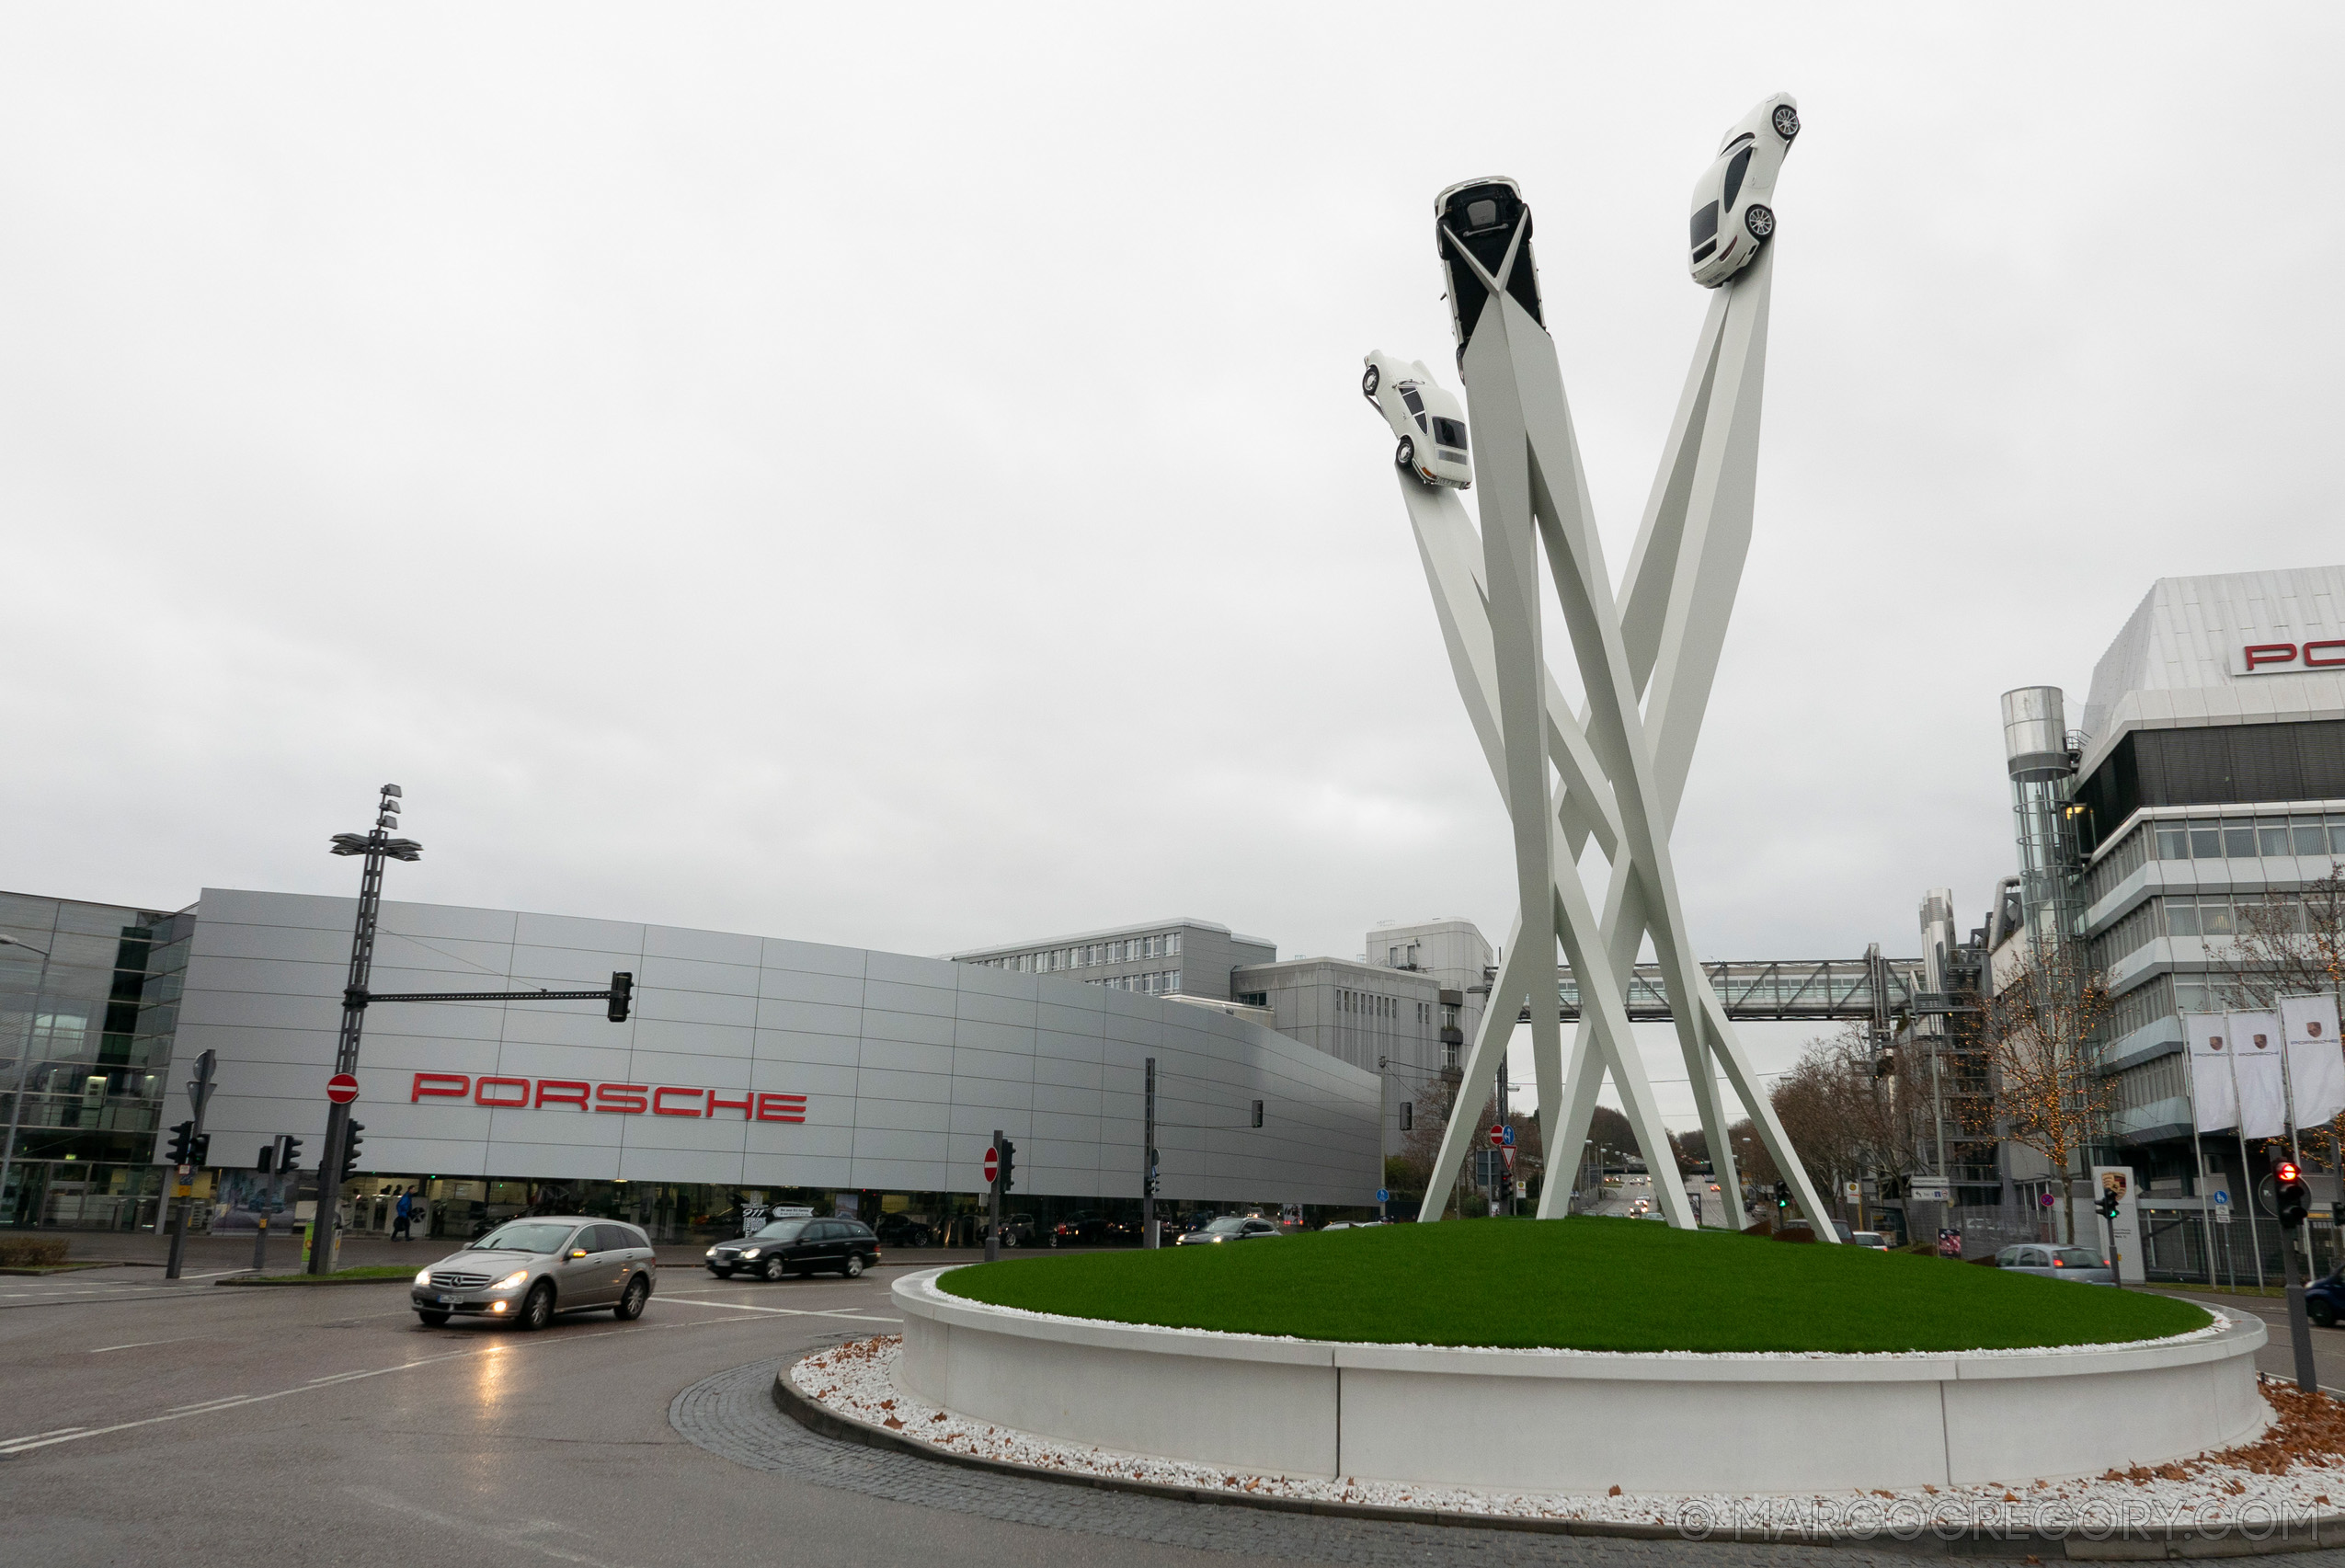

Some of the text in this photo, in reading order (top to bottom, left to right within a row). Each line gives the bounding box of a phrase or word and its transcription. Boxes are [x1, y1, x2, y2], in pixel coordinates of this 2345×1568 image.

[2245, 640, 2345, 670] PO
[411, 1072, 807, 1123] PORSCHE
[743, 1208, 765, 1217] 911
